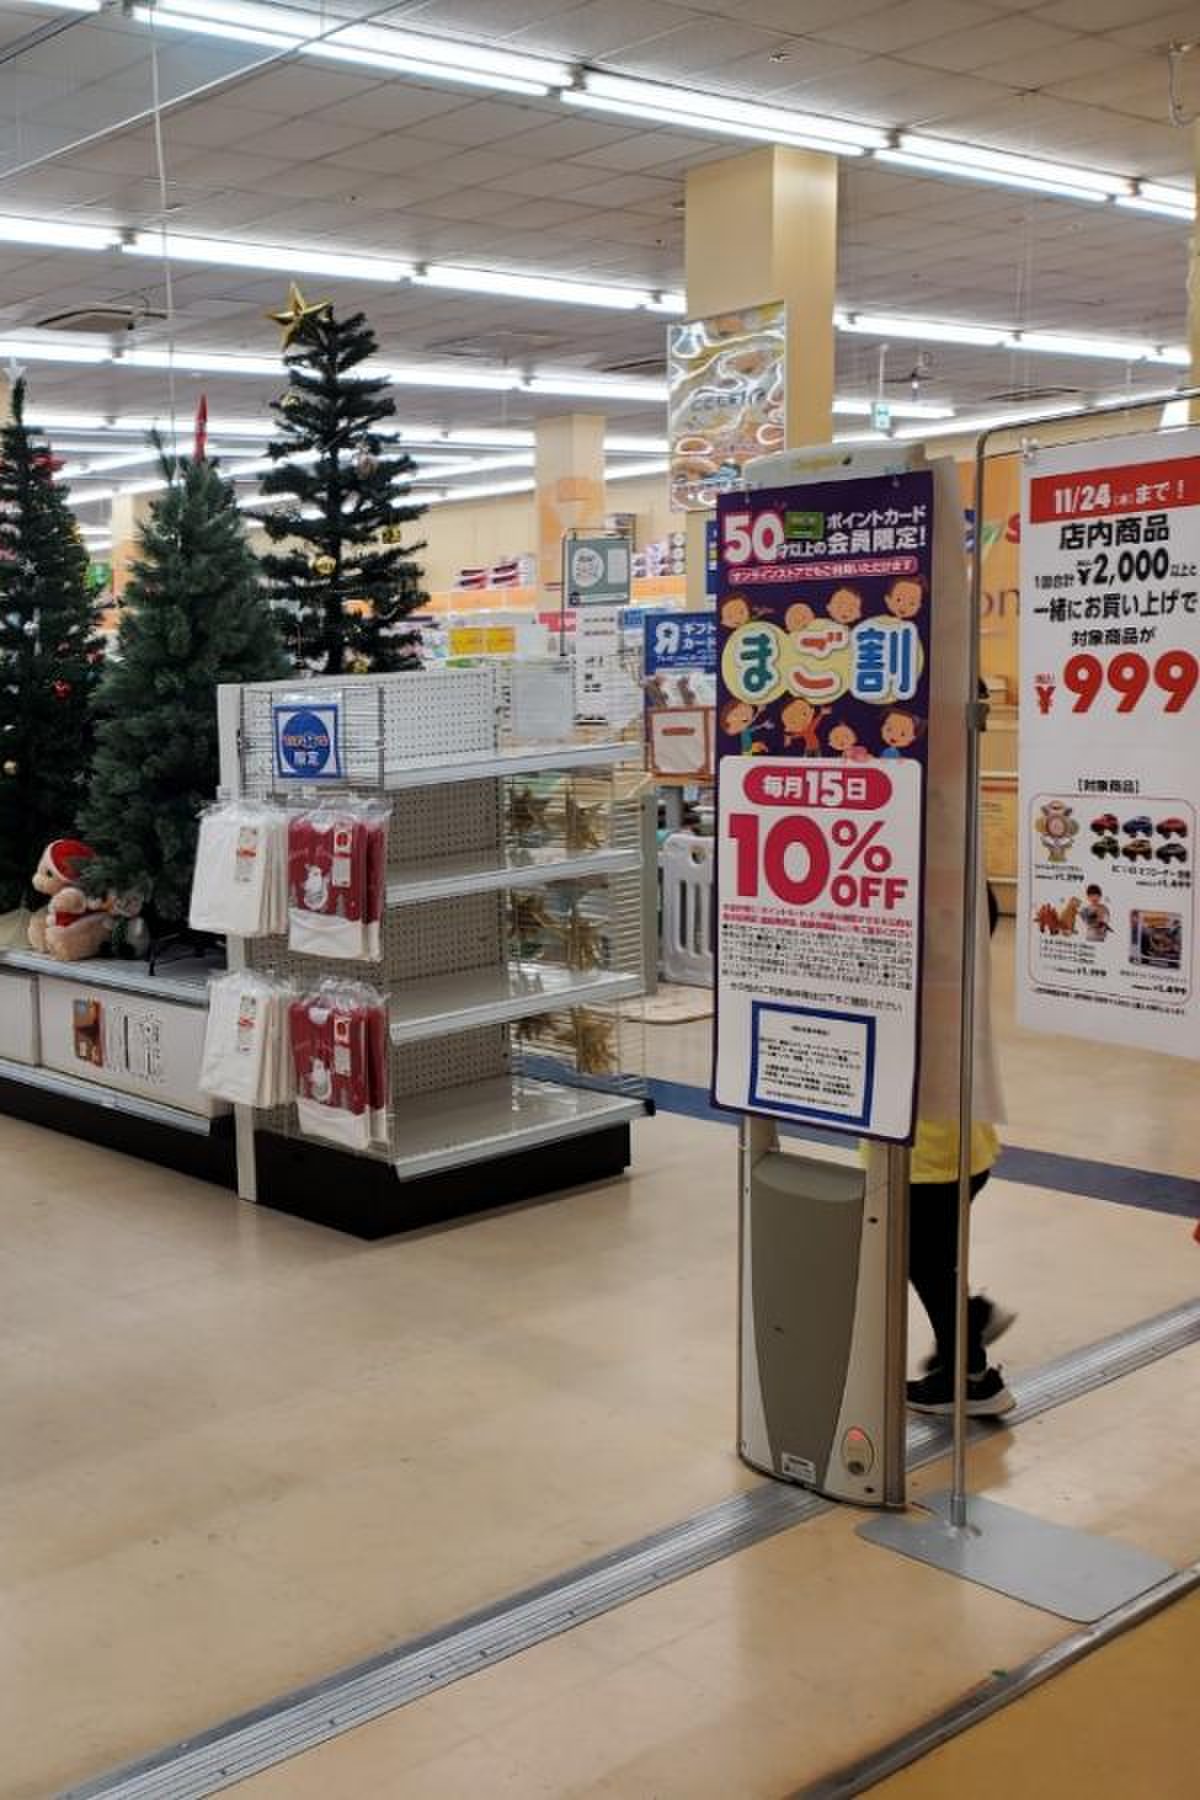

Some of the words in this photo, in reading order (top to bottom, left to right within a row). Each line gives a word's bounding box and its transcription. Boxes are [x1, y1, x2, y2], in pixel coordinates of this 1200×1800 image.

[827, 505, 926, 529] ポイントカード
[1059, 514, 1170, 550] 店内商品
[1033, 588, 1199, 623] 一緒にお買い上げで
[1071, 627, 1156, 647] 対象商品が
[740, 628, 912, 692] まご割
[762, 770, 867, 807] 毎月15日
[728, 813, 892, 906] 10%
[831, 874, 908, 910] OFF
